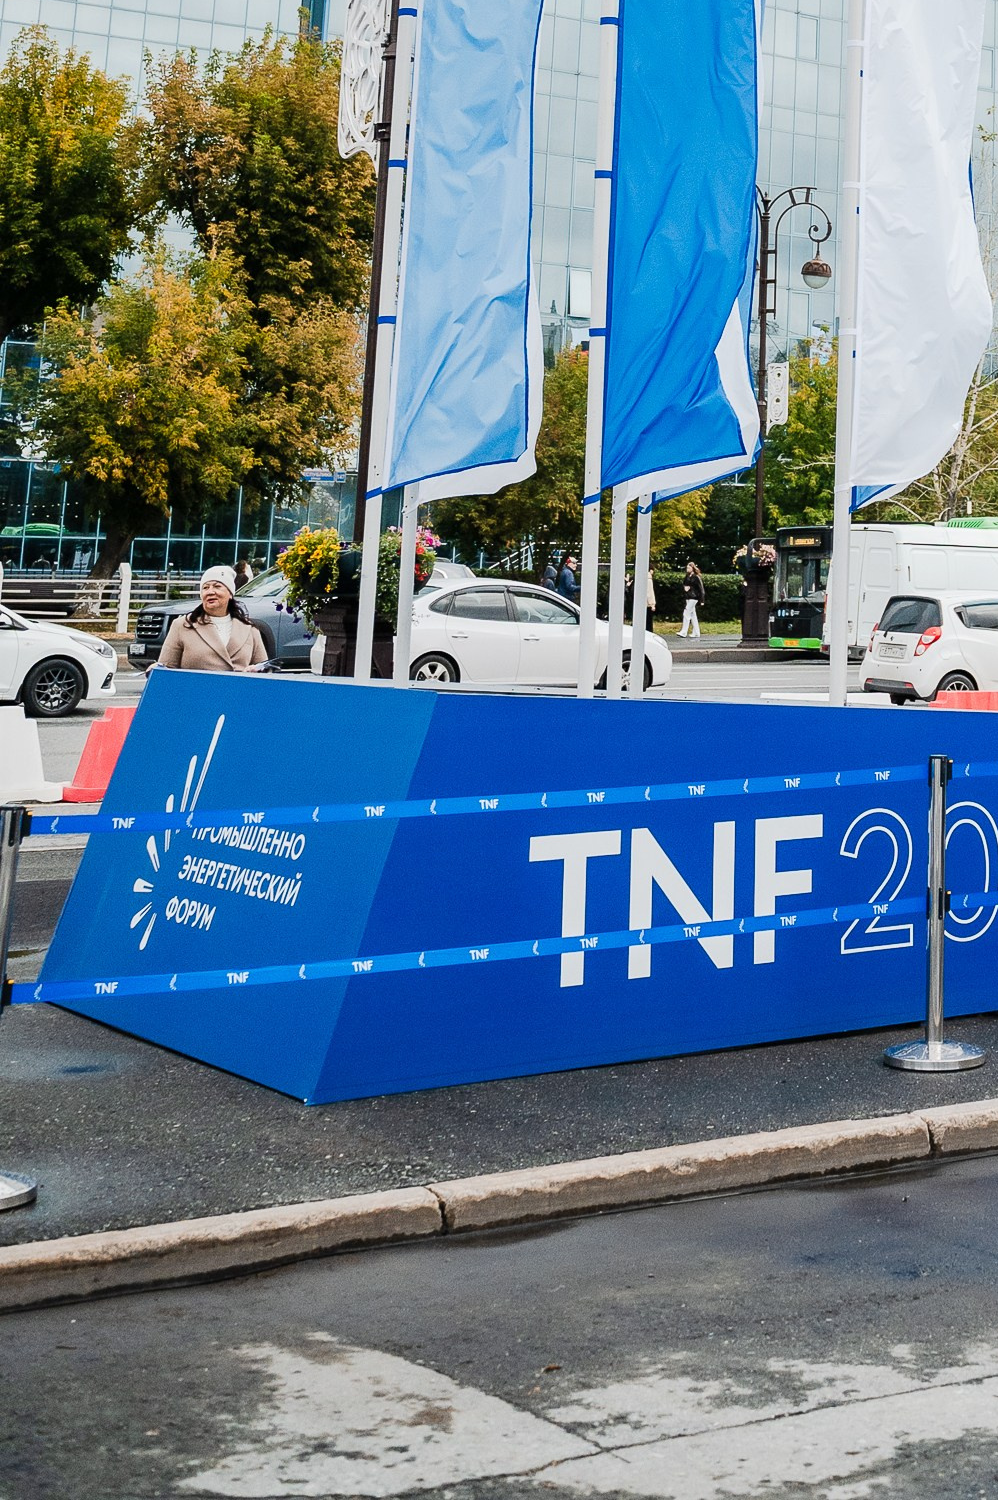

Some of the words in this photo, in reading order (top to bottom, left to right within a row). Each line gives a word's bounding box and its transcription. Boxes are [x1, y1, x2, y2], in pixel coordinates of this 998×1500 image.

[111, 817, 136, 829] TNF
[241, 811, 265, 824] TNF
[363, 805, 386, 818] TNF
[478, 798, 499, 810] TNF
[586, 791, 606, 803] TNF
[687, 785, 706, 796] TNF
[783, 777, 801, 788] TNF
[874, 770, 891, 781] TNF
[178, 855, 302, 907] ЭНЕРГЕТИЧЕСКИЙ
[528, 813, 824, 988] TNF
[165, 896, 217, 931] ФОРУМ
[94, 981, 119, 995] TNF
[226, 971, 250, 985] TNF
[351, 959, 374, 973] TNF
[469, 948, 490, 961] TNF
[579, 936, 599, 949] TNF
[682, 925, 702, 938] TNF
[779, 915, 797, 927] TNF
[872, 903, 889, 915] TNF
